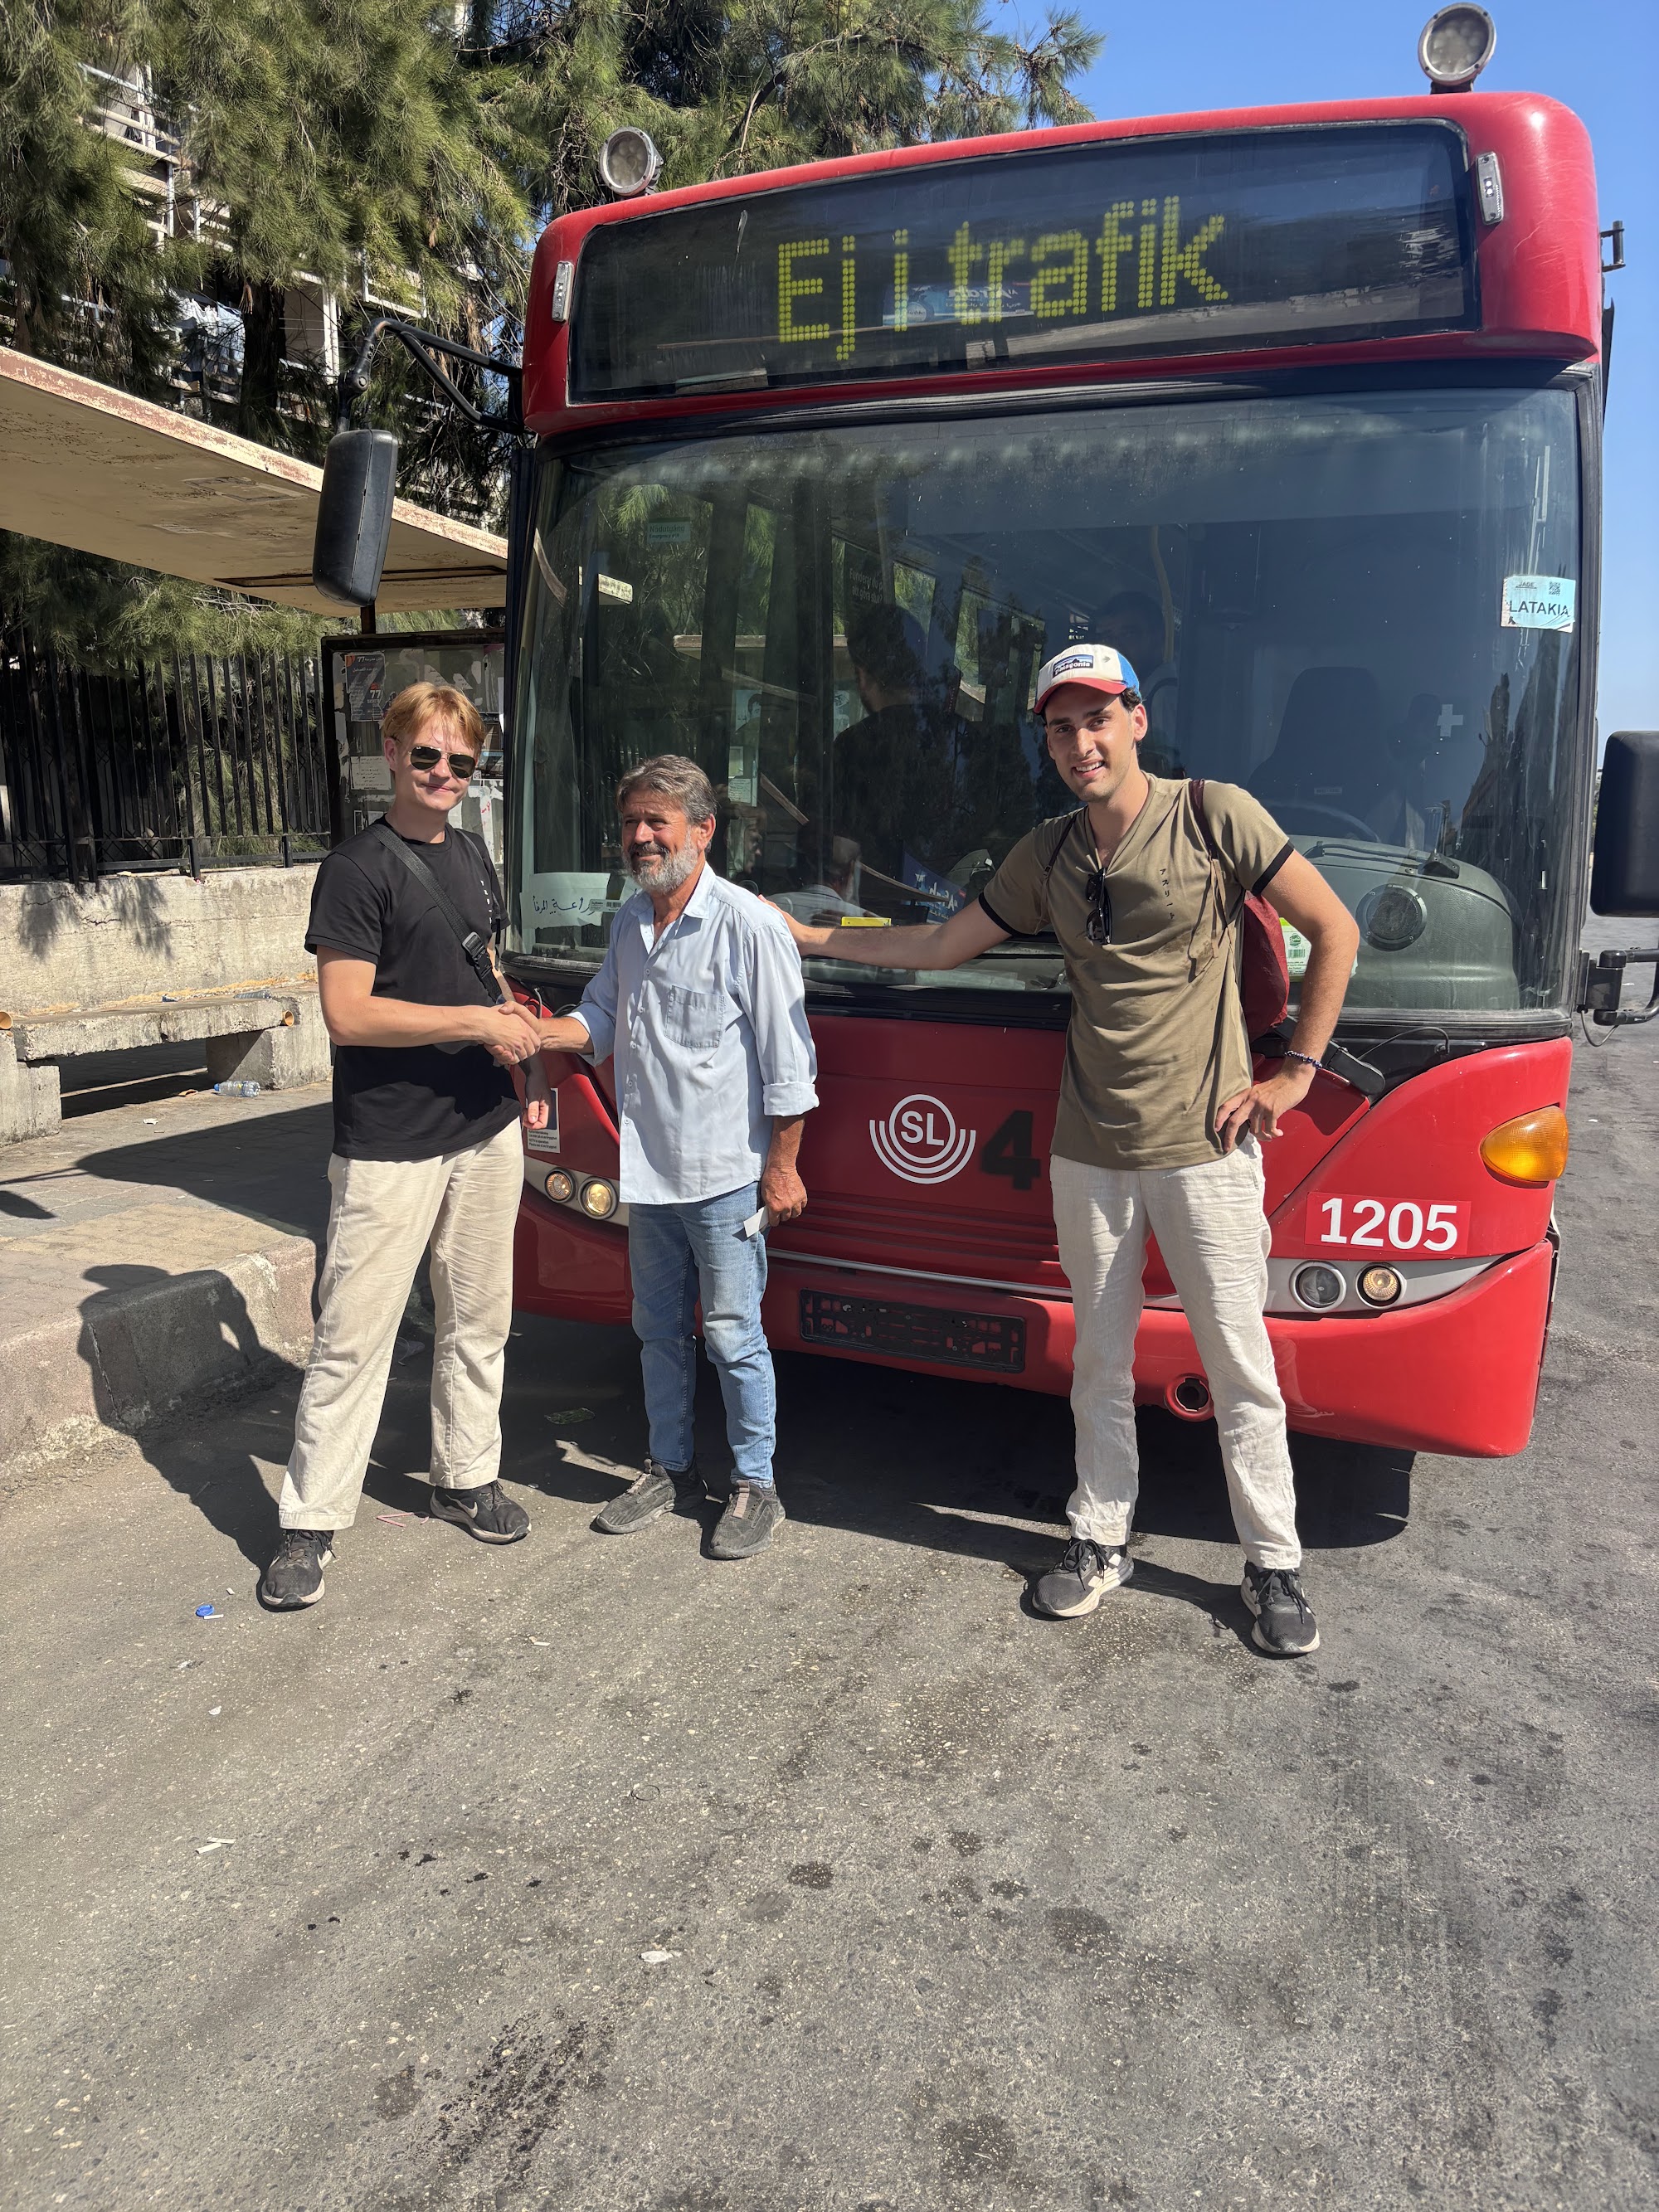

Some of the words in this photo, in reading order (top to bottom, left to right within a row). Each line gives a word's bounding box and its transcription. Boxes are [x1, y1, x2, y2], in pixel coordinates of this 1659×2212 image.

[777, 236, 855, 361] Ej
[893, 229, 909, 332] i
[949, 195, 1229, 325] trafik
[1508, 600, 1569, 617] LATAKIA
[369, 689, 382, 699] 77
[901, 1111, 945, 1145] SL
[980, 1110, 1041, 1190] 4
[1321, 1197, 1458, 1252] 1205
